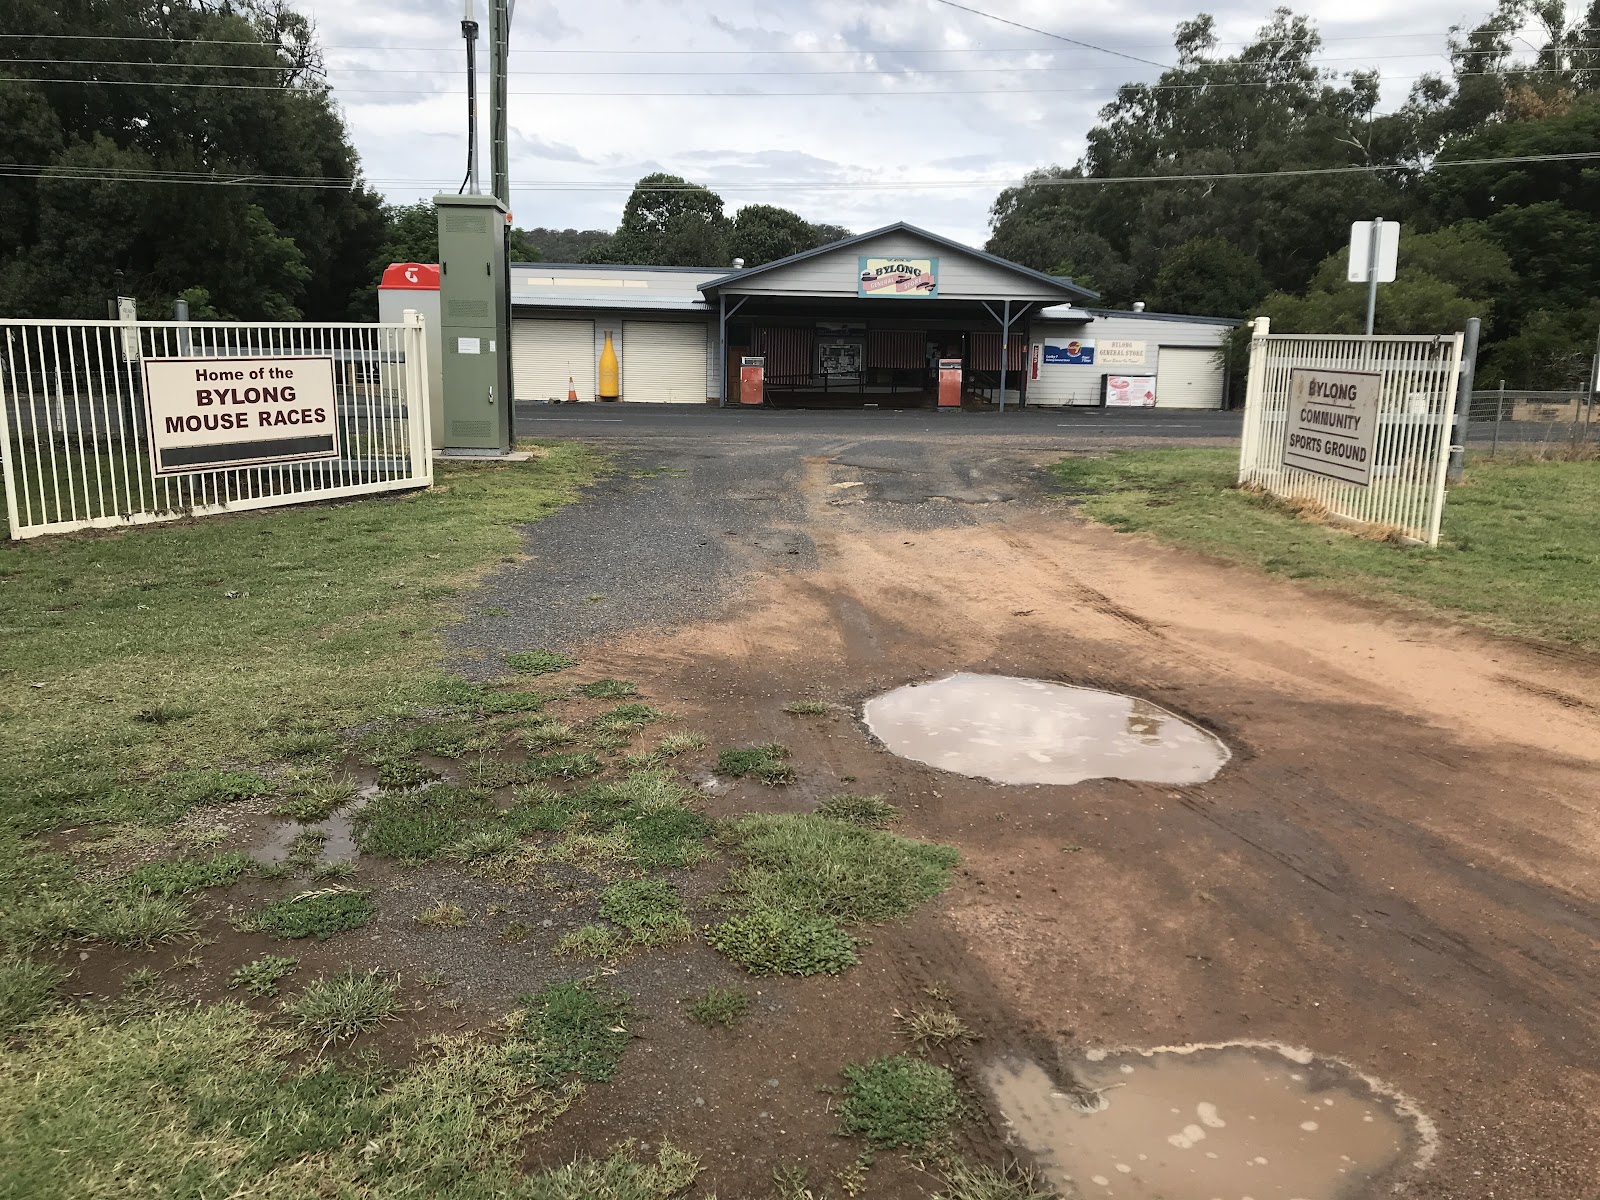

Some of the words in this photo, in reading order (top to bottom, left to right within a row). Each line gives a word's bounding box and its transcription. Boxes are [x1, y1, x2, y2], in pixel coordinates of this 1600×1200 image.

[876, 264, 921, 276] BYLONG
[870, 277, 894, 288] GENERAL
[904, 278, 922, 289] STORE
[195, 368, 244, 381] Home
[249, 367, 265, 380] of
[268, 367, 294, 379] the
[196, 386, 296, 407] BYLONG
[1308, 380, 1357, 401] BYLONG
[165, 412, 249, 434] MOUSE
[258, 407, 326, 427] RACES
[1300, 408, 1361, 431] COMMUNITY
[1289, 433, 1322, 453] SPORTS
[1324, 440, 1367, 462] GROUND
